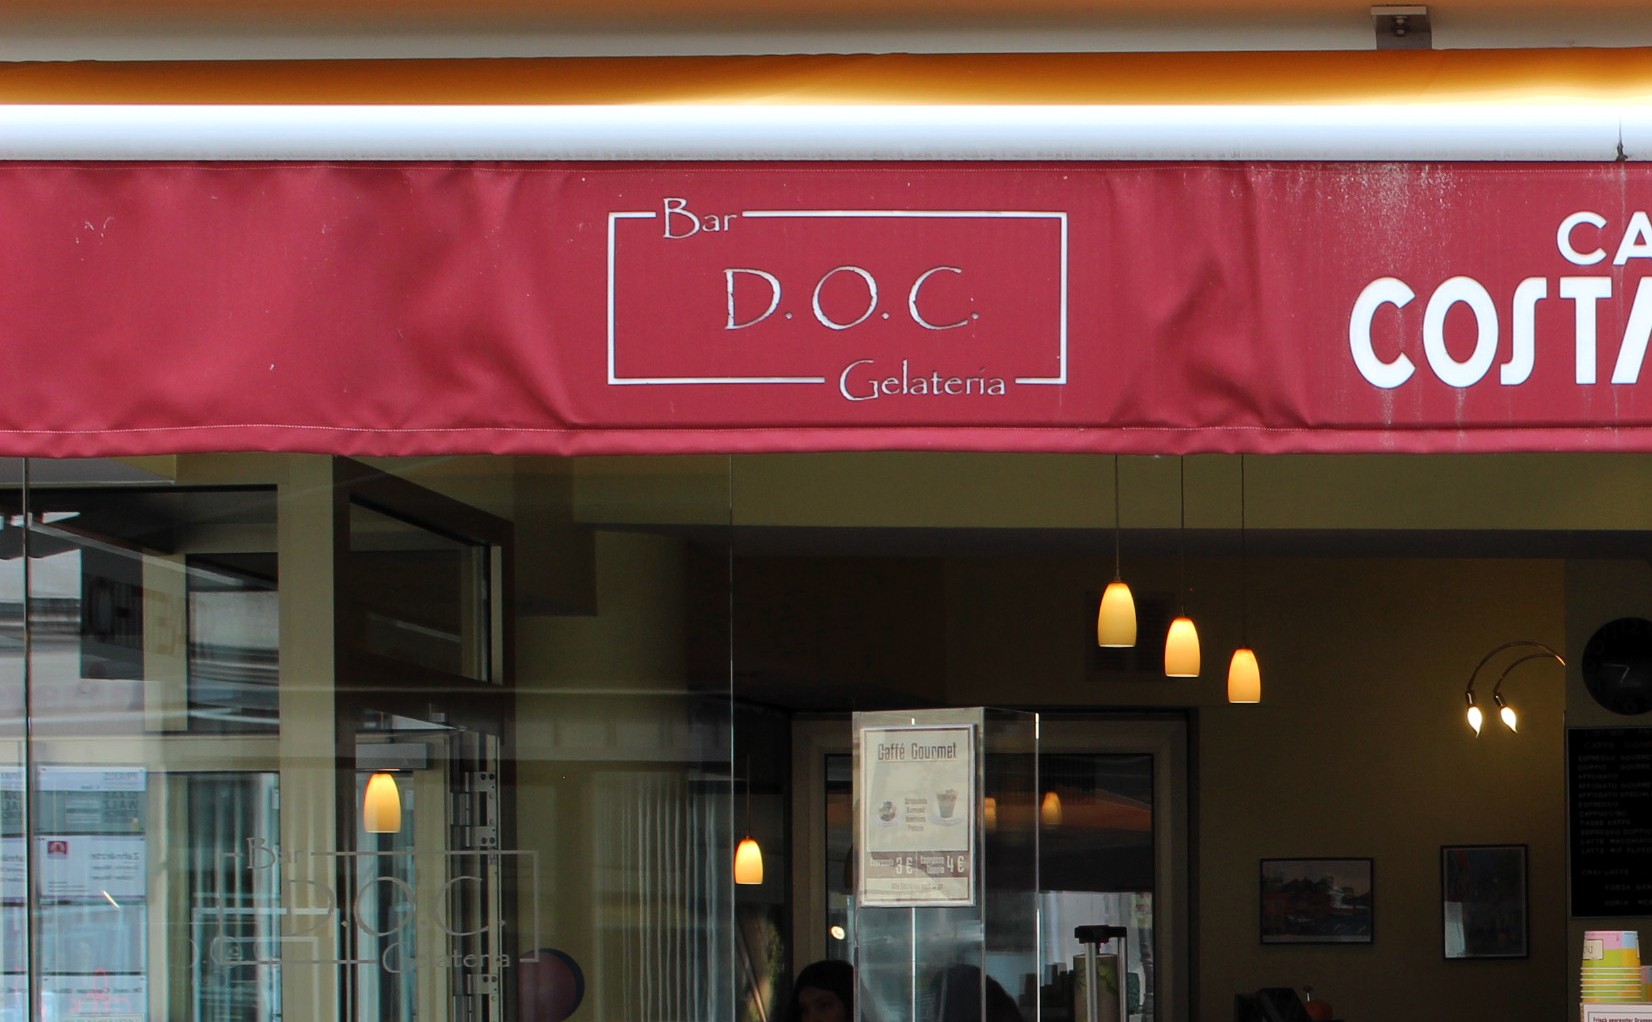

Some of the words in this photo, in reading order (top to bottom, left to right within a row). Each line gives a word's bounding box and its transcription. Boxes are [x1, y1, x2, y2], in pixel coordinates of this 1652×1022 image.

[662, 197, 737, 239] Bar
[839, 359, 1006, 402] Gelateria
[911, 742, 957, 760] Gourmet
[246, 837, 302, 870] Bar
[895, 858, 903, 874] 3
[906, 857, 914, 874] €
[946, 855, 955, 873] 4
[957, 855, 966, 873] €
